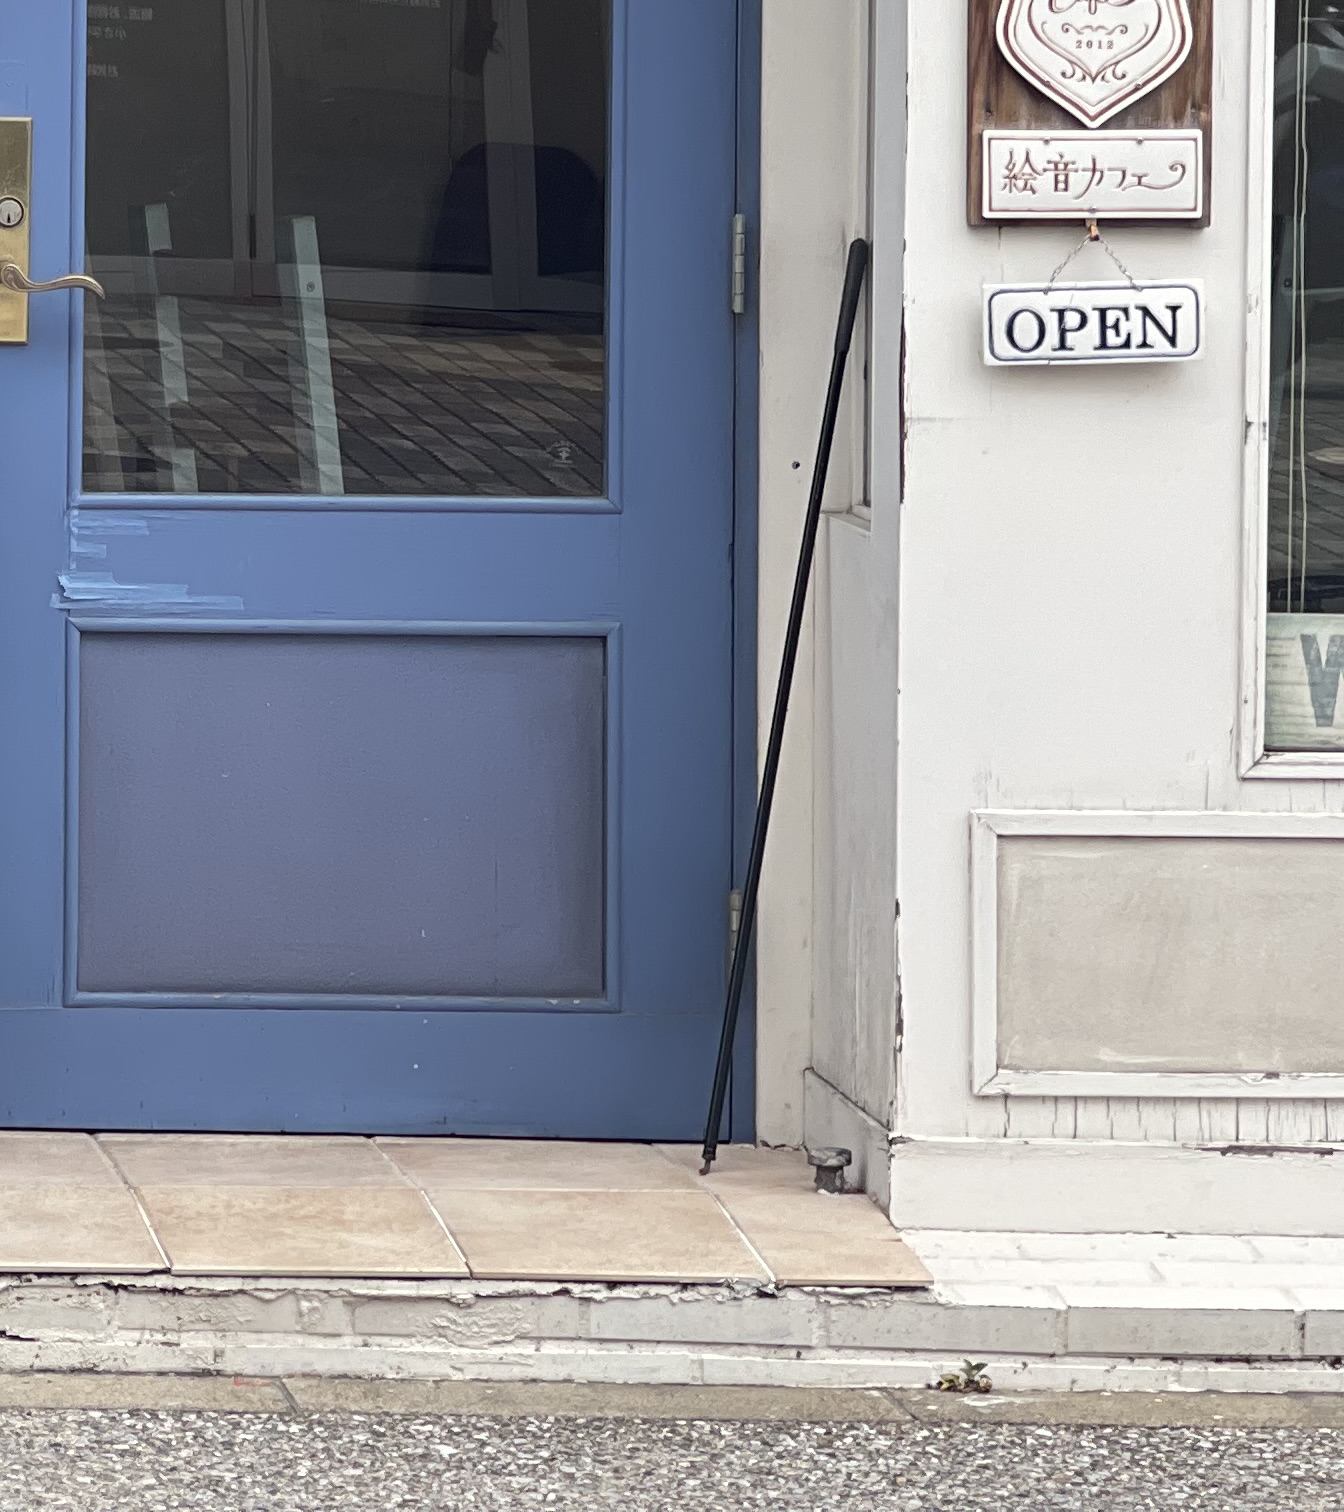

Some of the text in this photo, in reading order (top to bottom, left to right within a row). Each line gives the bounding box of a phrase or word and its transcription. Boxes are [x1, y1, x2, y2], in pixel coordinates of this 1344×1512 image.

[1002, 148, 1186, 200] 絵音カフェ
[1005, 304, 1183, 354] OPEN
